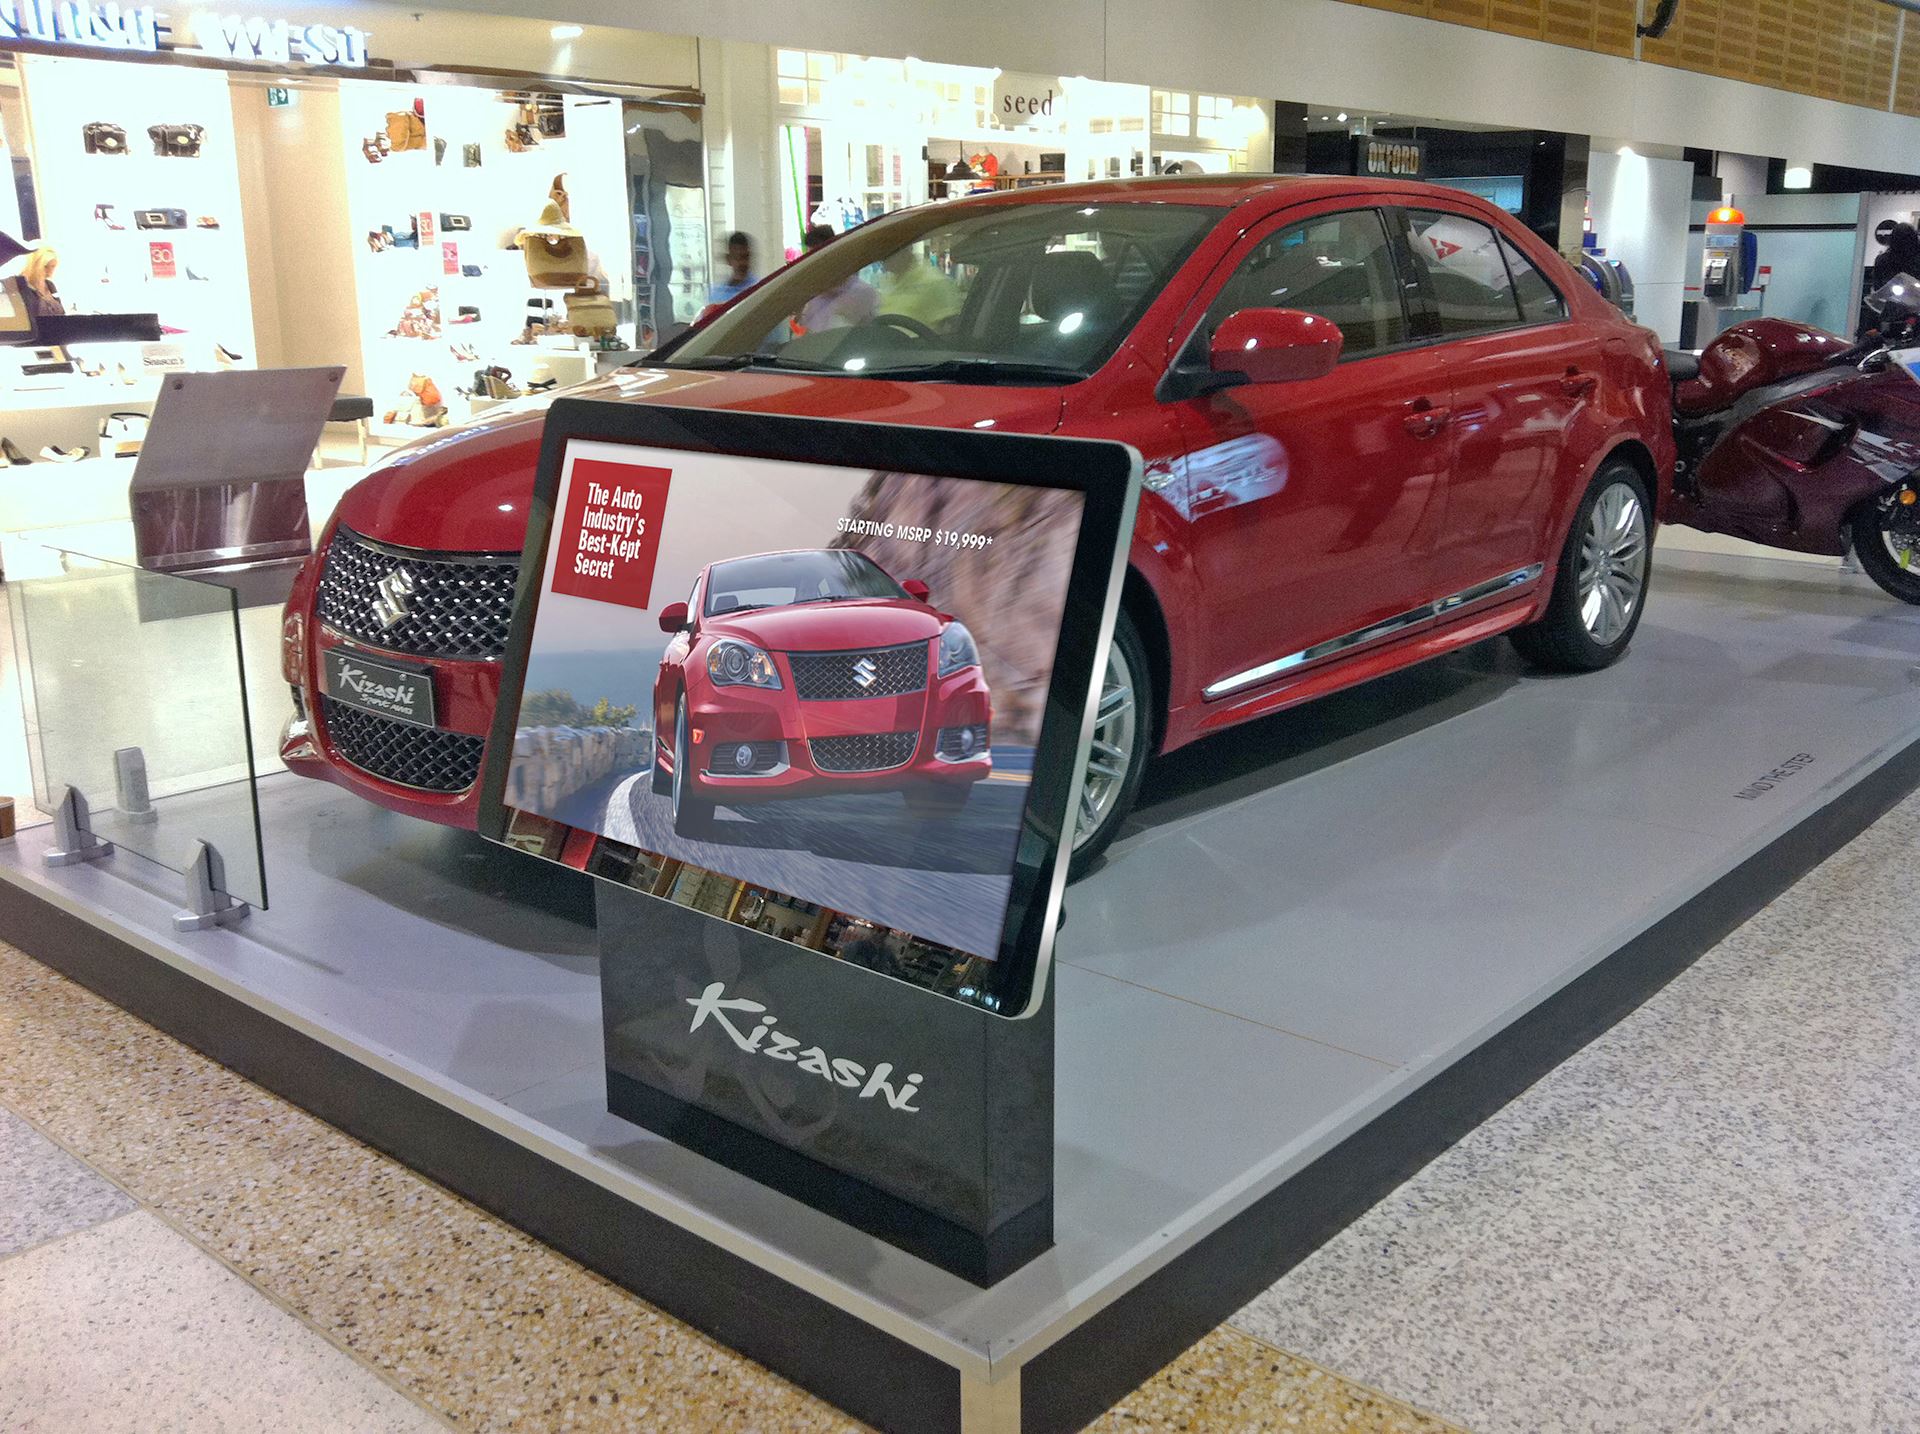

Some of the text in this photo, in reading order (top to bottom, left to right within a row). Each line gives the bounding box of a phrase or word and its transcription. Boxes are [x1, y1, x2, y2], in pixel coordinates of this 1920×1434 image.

[192, 13, 372, 67] WEST
[1003, 89, 1053, 116] seed
[1367, 141, 1420, 175] OXFORD
[587, 482, 643, 511] The Auto
[582, 506, 646, 538] Industry's
[836, 517, 894, 538] STARTING
[896, 525, 932, 543] MSRP
[578, 529, 641, 562] Best-Kept
[574, 552, 614, 580] Secret
[337, 664, 415, 704] Kizashi
[1780, 752, 1815, 771] STEP
[685, 981, 923, 1113] Kizashi
